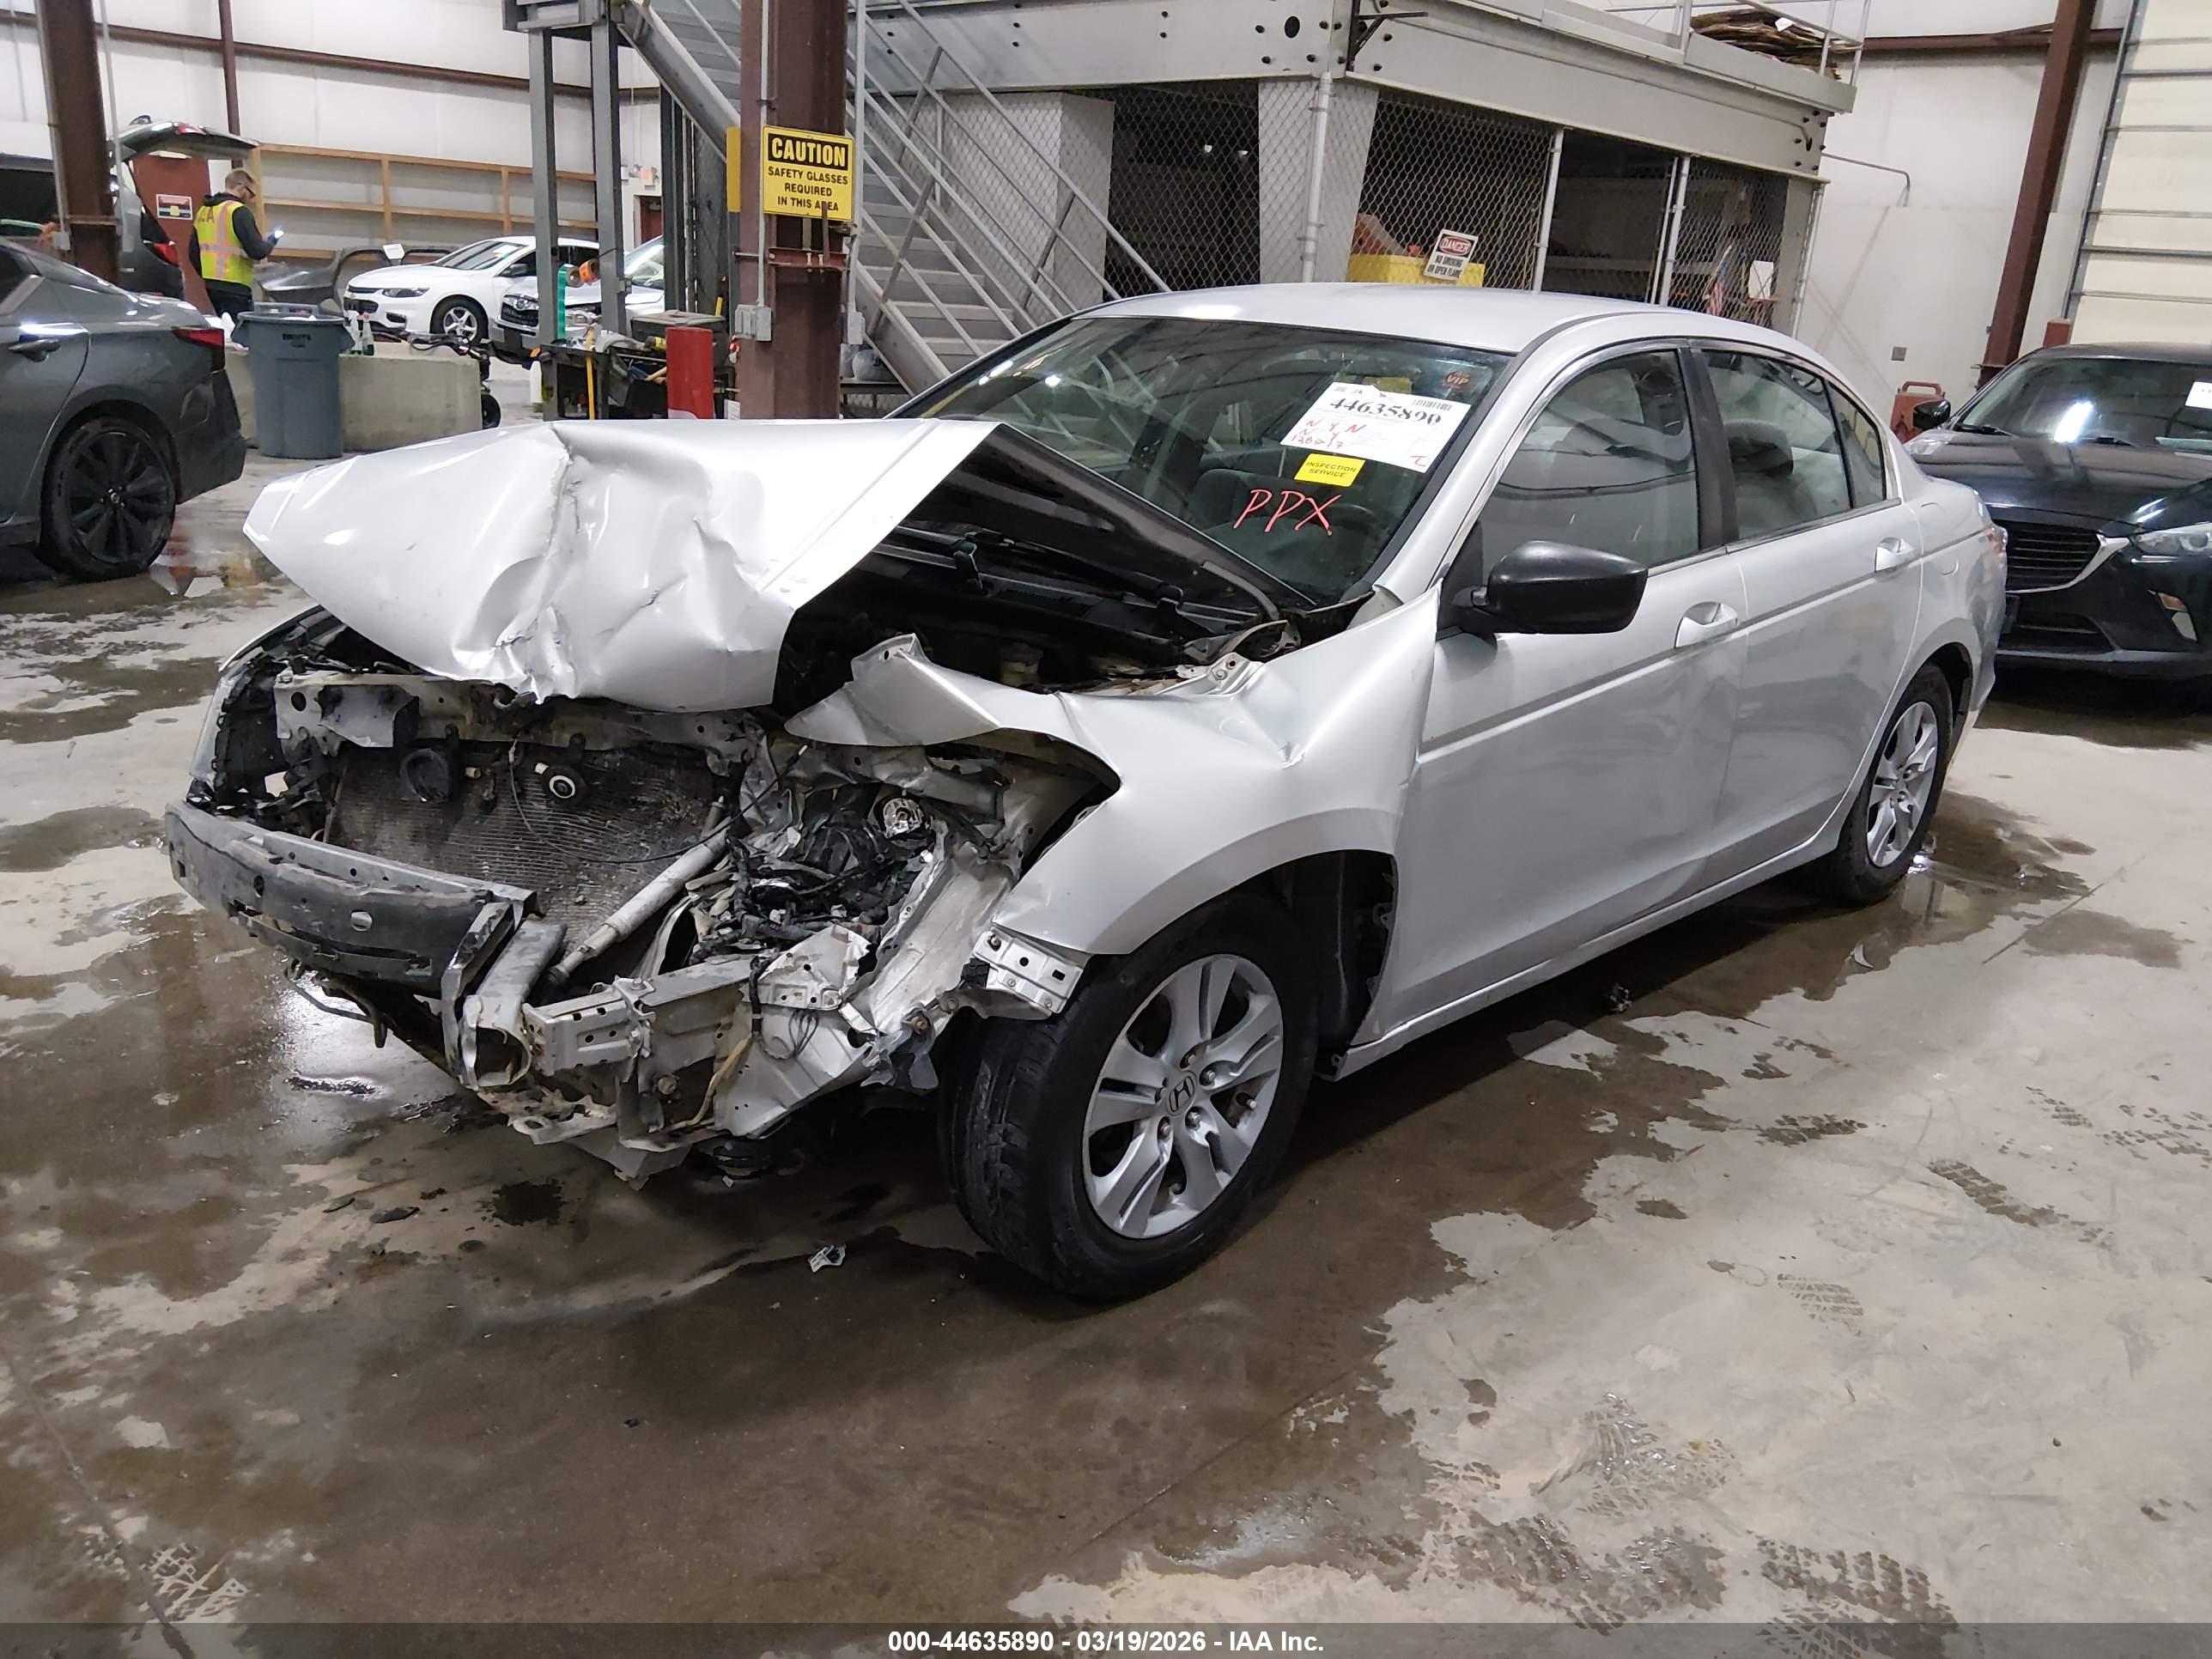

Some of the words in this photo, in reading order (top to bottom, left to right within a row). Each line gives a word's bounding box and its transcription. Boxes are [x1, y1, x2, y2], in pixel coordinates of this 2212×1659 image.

[772, 137, 846, 167] CAUTION
[768, 166, 804, 179] SAFETY
[806, 172, 848, 185] GLASSES
[784, 182, 833, 197] REQUIRED
[777, 195, 787, 206] IN
[790, 197, 812, 209] THIS
[1442, 238, 1471, 252] DANGER
[1329, 398, 1442, 427] 44635890
[1305, 461, 1357, 472] INSPECTION
[1309, 468, 1348, 478] SERVICE
